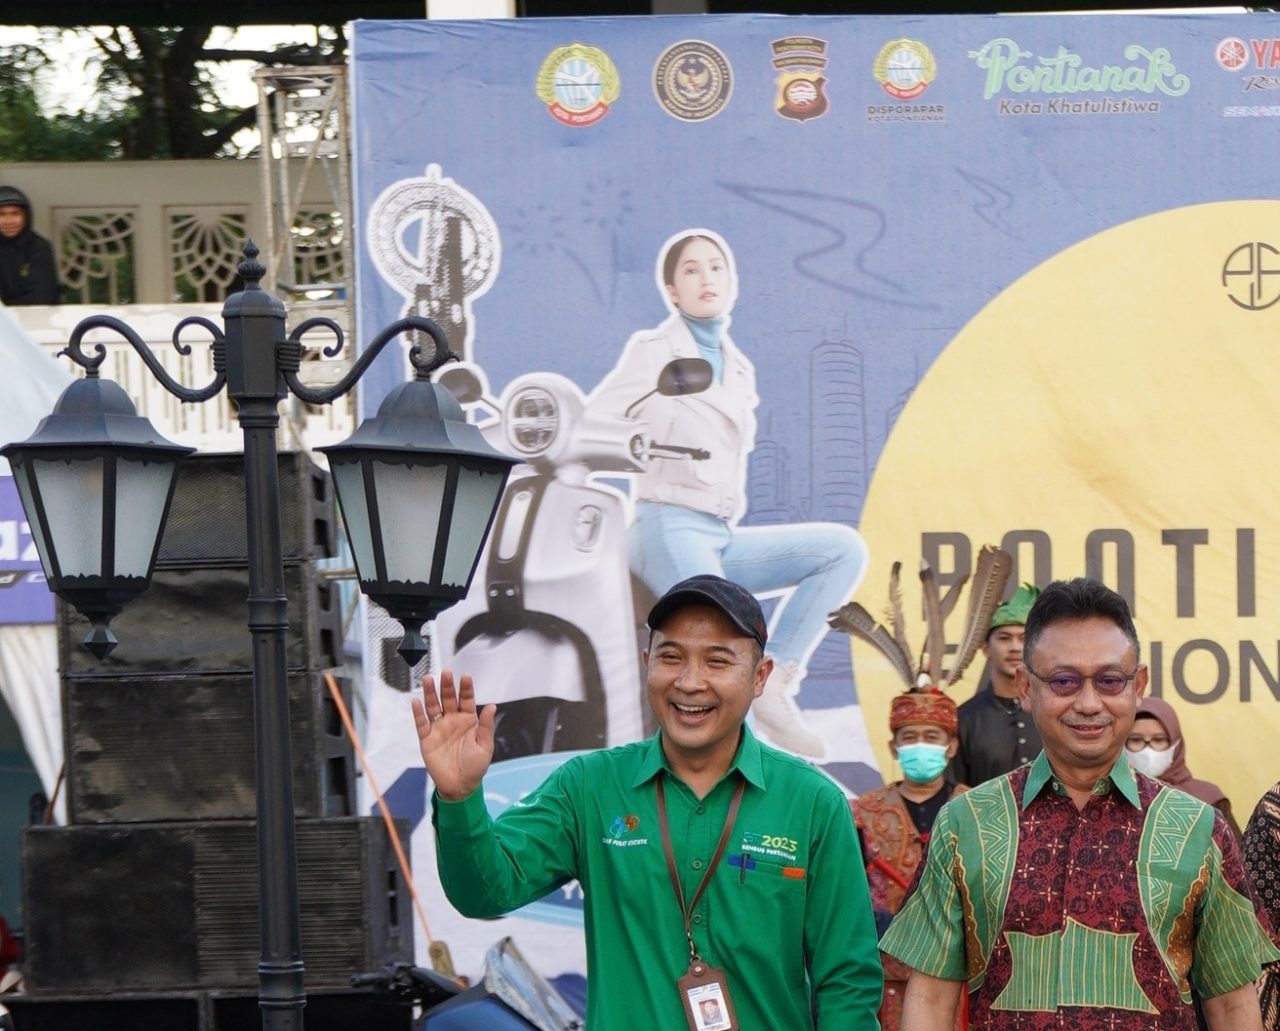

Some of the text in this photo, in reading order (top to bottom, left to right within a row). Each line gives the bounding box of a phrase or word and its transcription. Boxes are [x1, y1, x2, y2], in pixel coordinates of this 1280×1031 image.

[975, 37, 1191, 100] Pontianak
[867, 105, 945, 114] DISPORAPAR
[999, 97, 1161, 115] Kota Khatulistiwa
